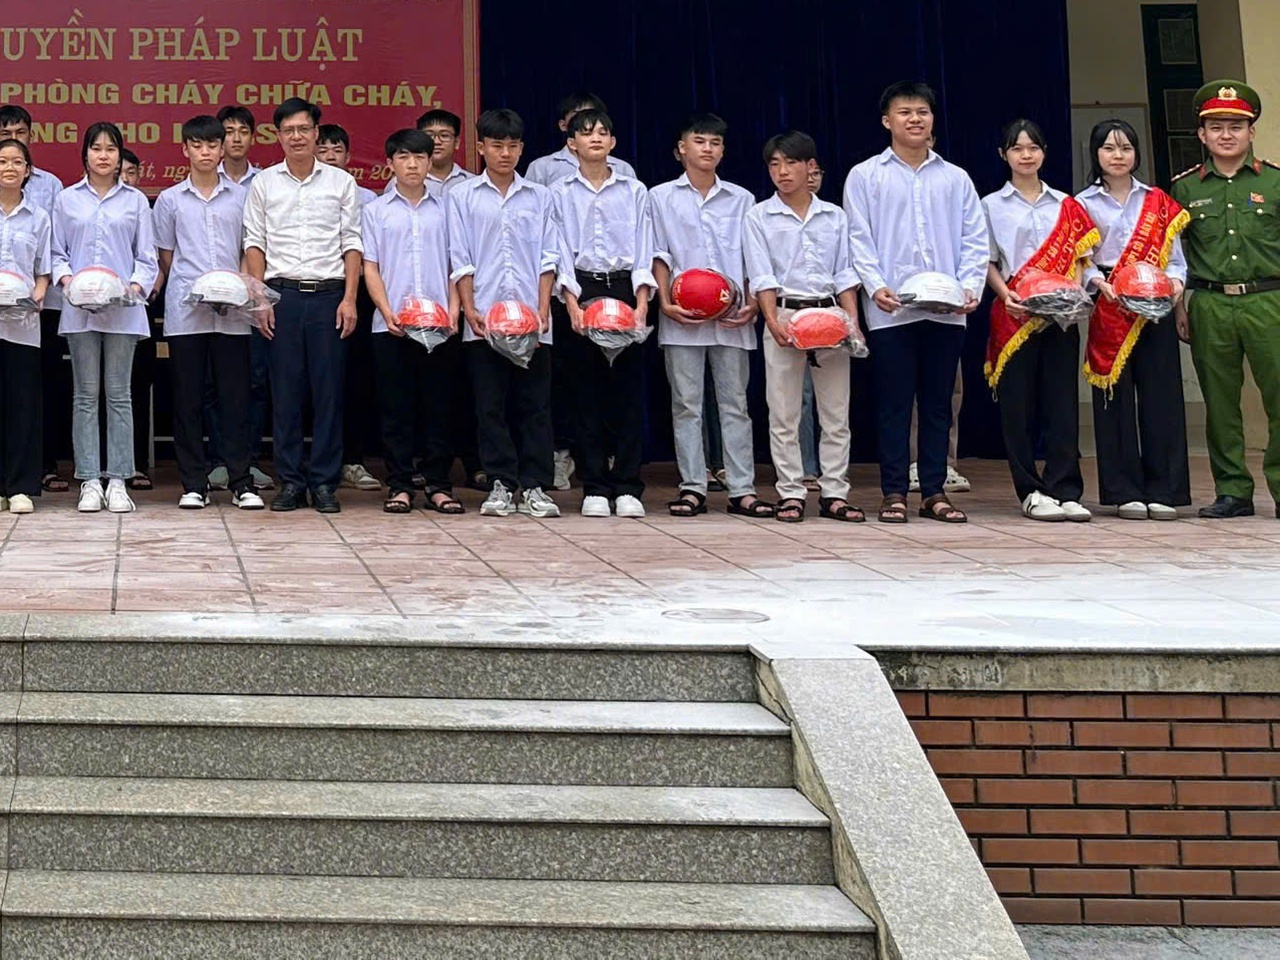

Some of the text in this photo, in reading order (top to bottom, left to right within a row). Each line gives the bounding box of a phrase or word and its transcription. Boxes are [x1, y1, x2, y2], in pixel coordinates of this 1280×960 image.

[129, 16, 240, 62] PHÁP
[252, 17, 363, 71] LUẬT
[0, 78, 120, 105] PHÒNG
[131, 78, 224, 105] CHÁY
[235, 80, 332, 106] CHỮA
[344, 80, 443, 108] CHÁY,
[113, 122, 161, 144] HO
